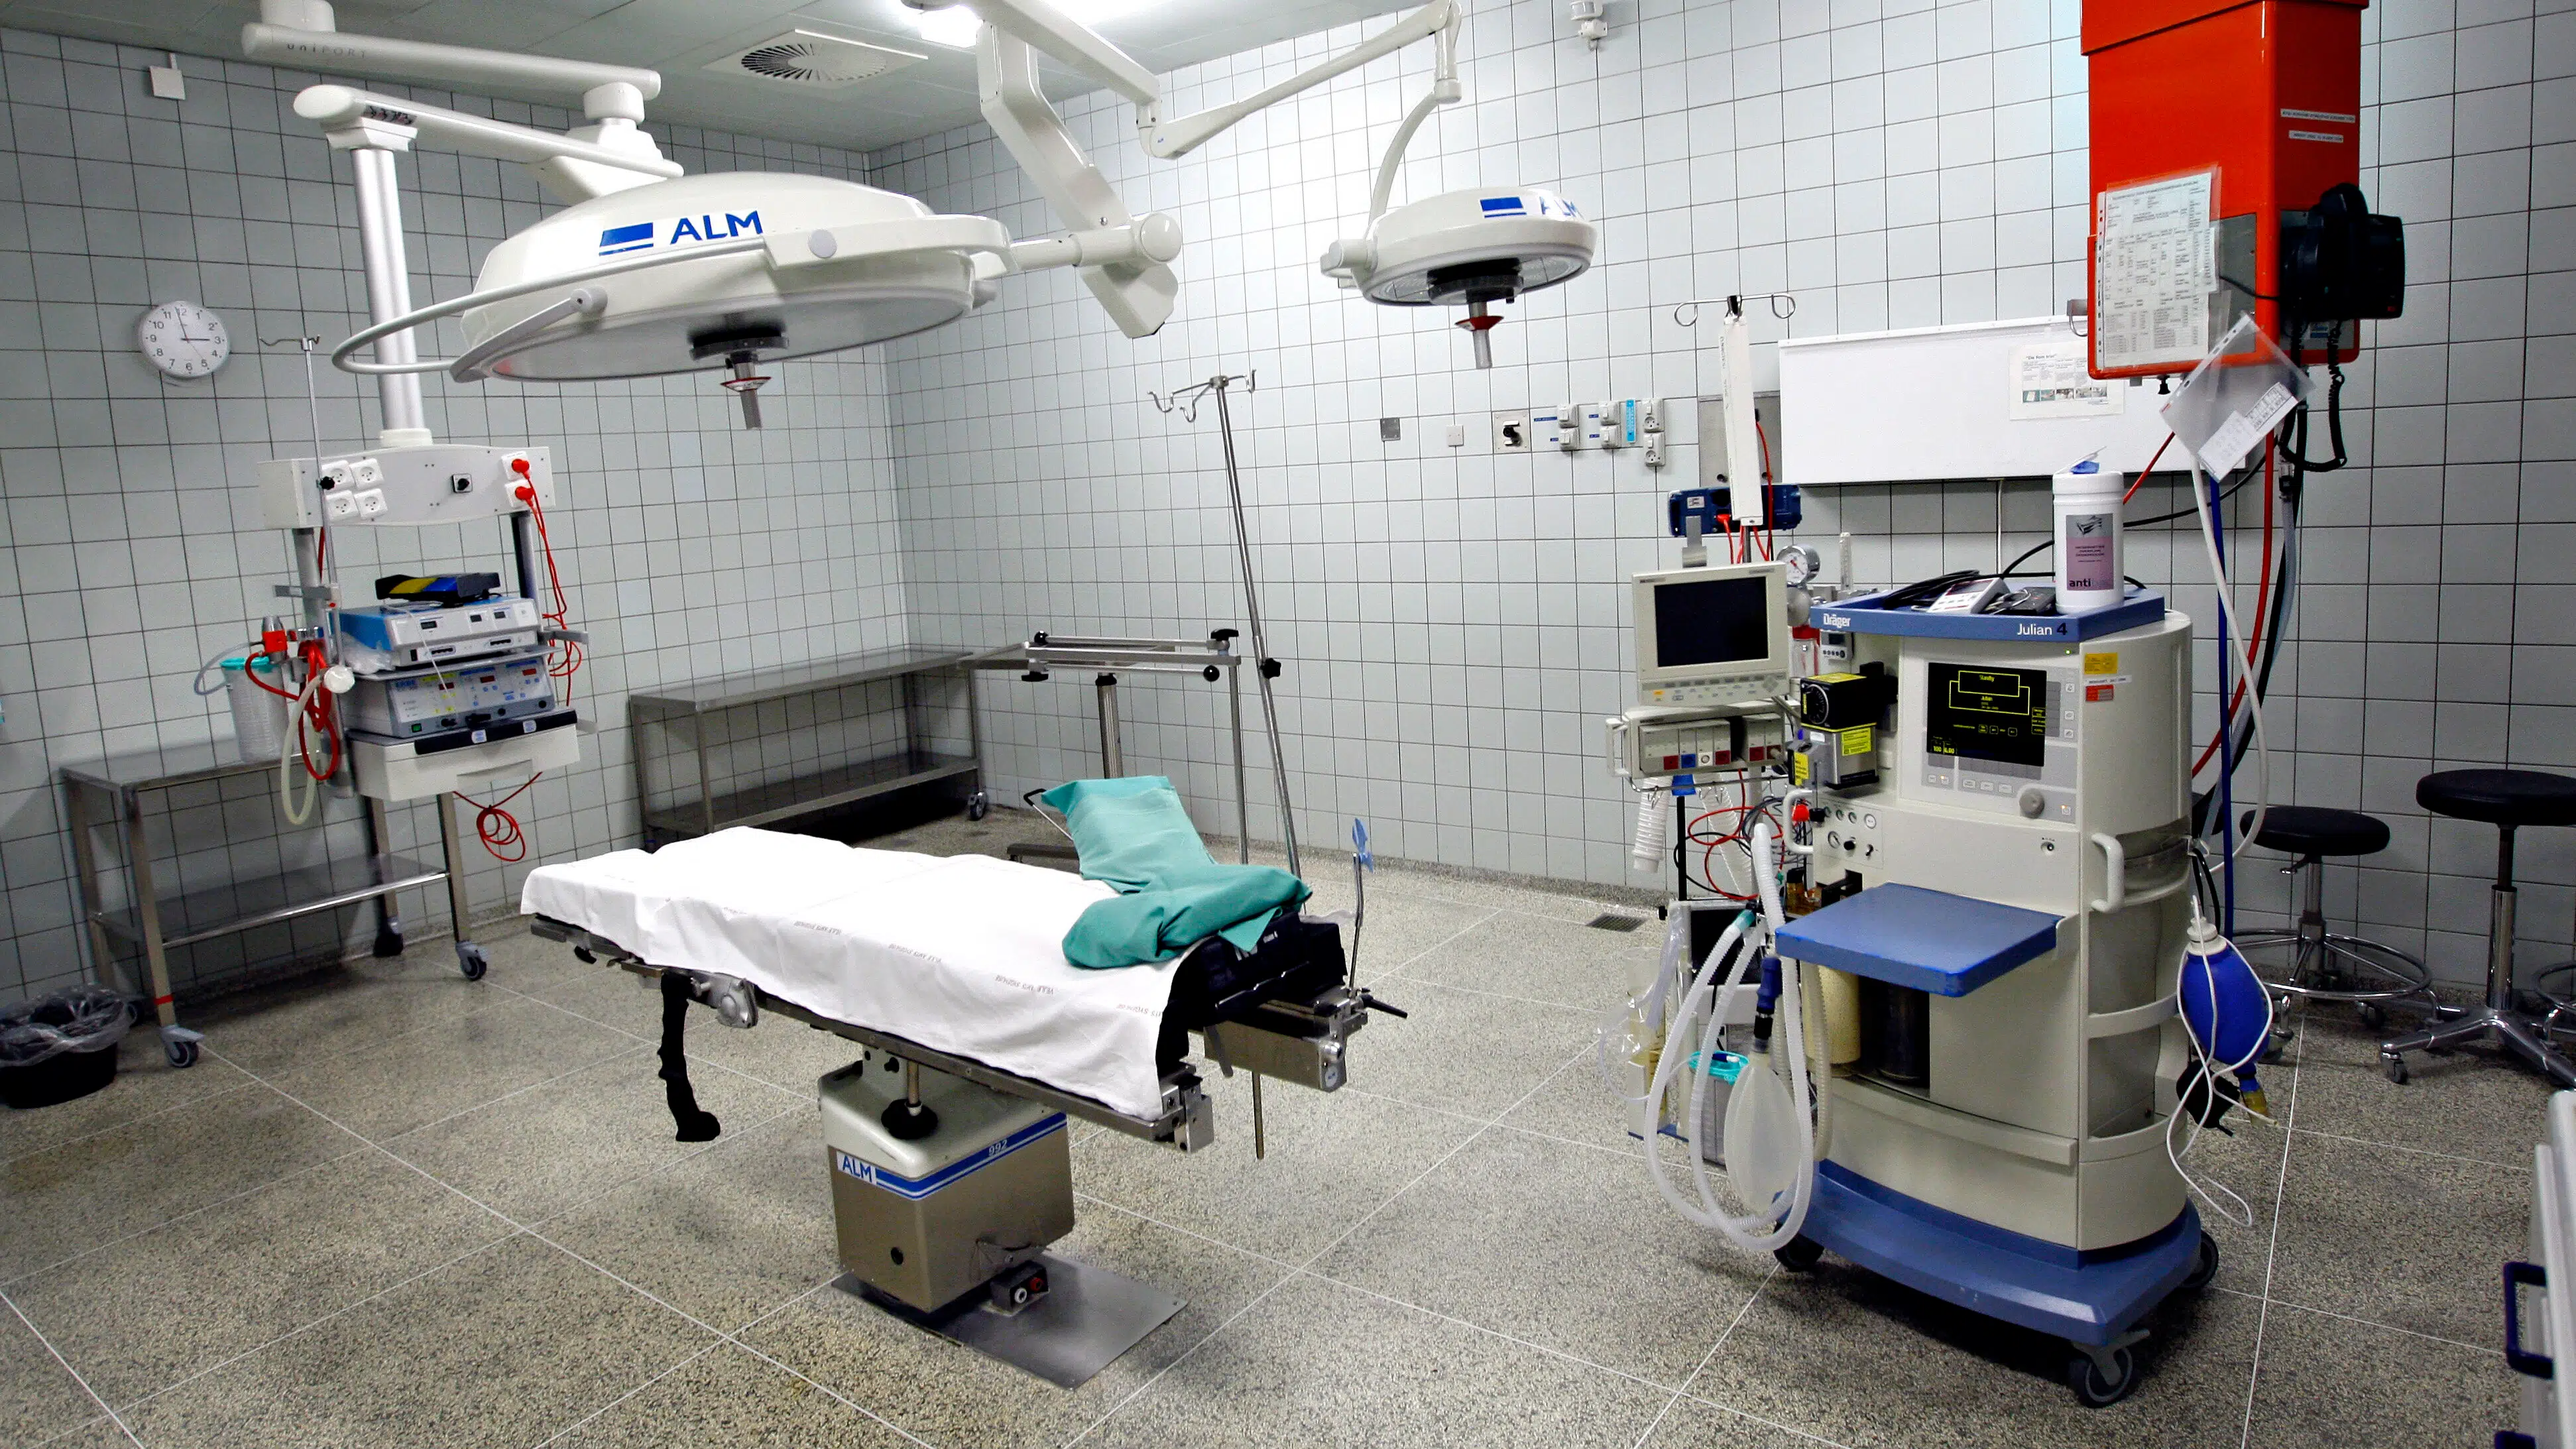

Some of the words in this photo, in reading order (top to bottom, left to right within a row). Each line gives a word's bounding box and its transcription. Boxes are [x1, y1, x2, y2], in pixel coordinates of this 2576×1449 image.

[670, 209, 763, 245] ALM
[163, 311, 172, 319] 11
[152, 321, 164, 329] 10
[149, 334, 157, 343] 9
[214, 335, 221, 344] 3
[156, 348, 164, 357] 8
[186, 362, 193, 371] 6
[201, 359, 208, 367] 5
[1823, 613, 1851, 629] Dräger
[2017, 623, 2052, 636] Julian
[2056, 622, 2068, 636] 4
[988, 1139, 1007, 1156] 992
[842, 1155, 872, 1183] ALM
